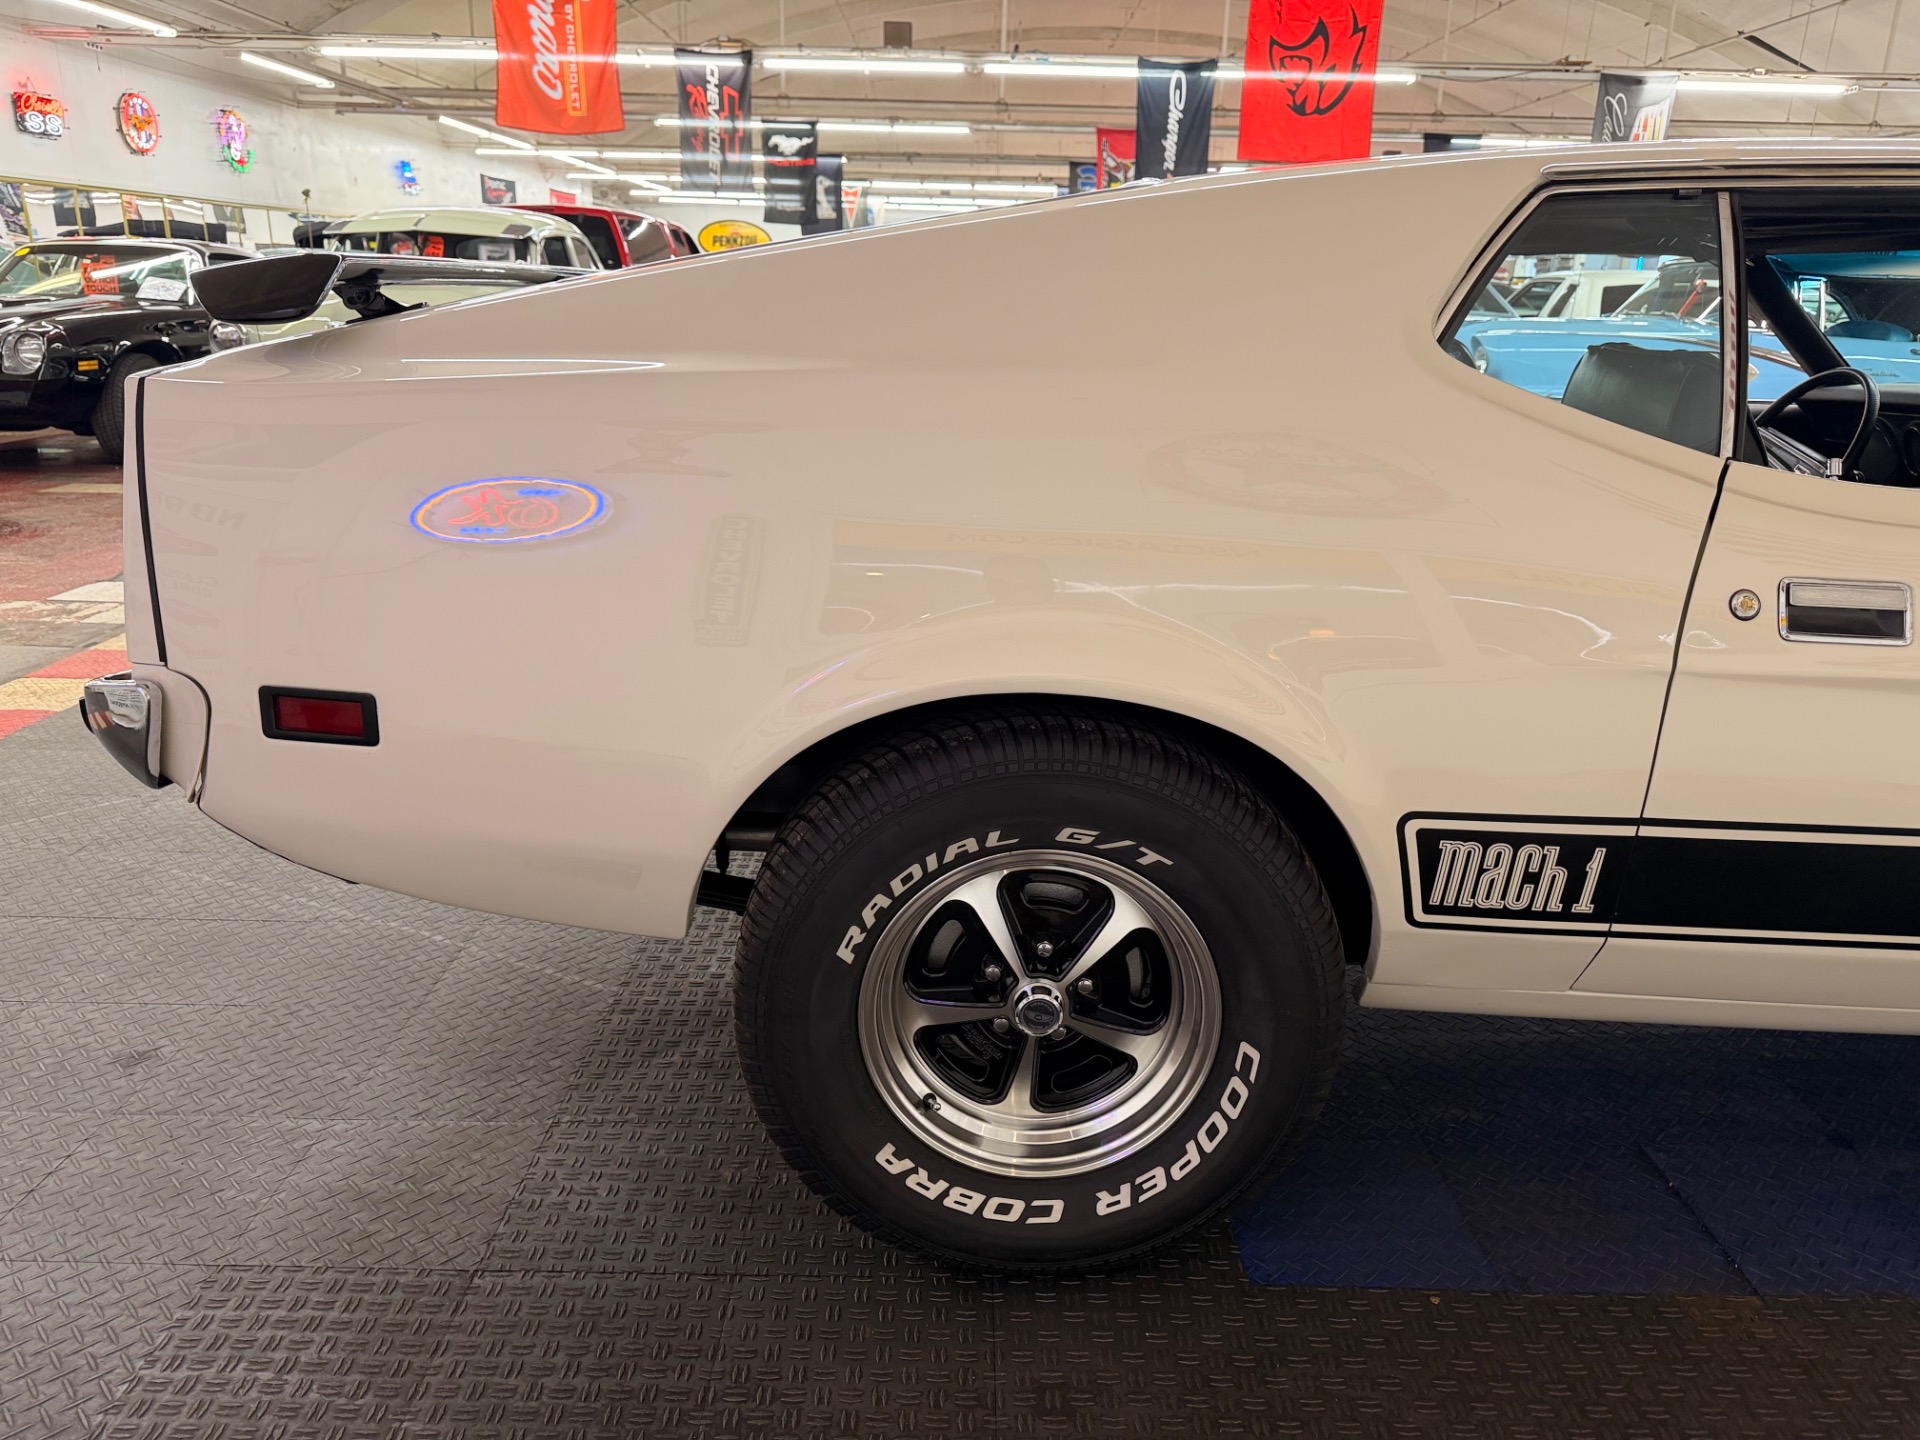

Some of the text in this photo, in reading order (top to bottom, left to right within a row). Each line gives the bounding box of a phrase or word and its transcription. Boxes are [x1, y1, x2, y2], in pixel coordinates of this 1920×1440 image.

[564, 4, 580, 109] BY CHEVROLET
[25, 111, 63, 135] SS
[705, 64, 721, 186] CHEVROLET
[1161, 70, 1187, 172] Charger
[85, 284, 117, 293] TOUCH
[835, 827, 1174, 964] RADIAL G/T
[1428, 840, 1607, 913] mach 1
[875, 1041, 1261, 1224] COOPER COBRA
